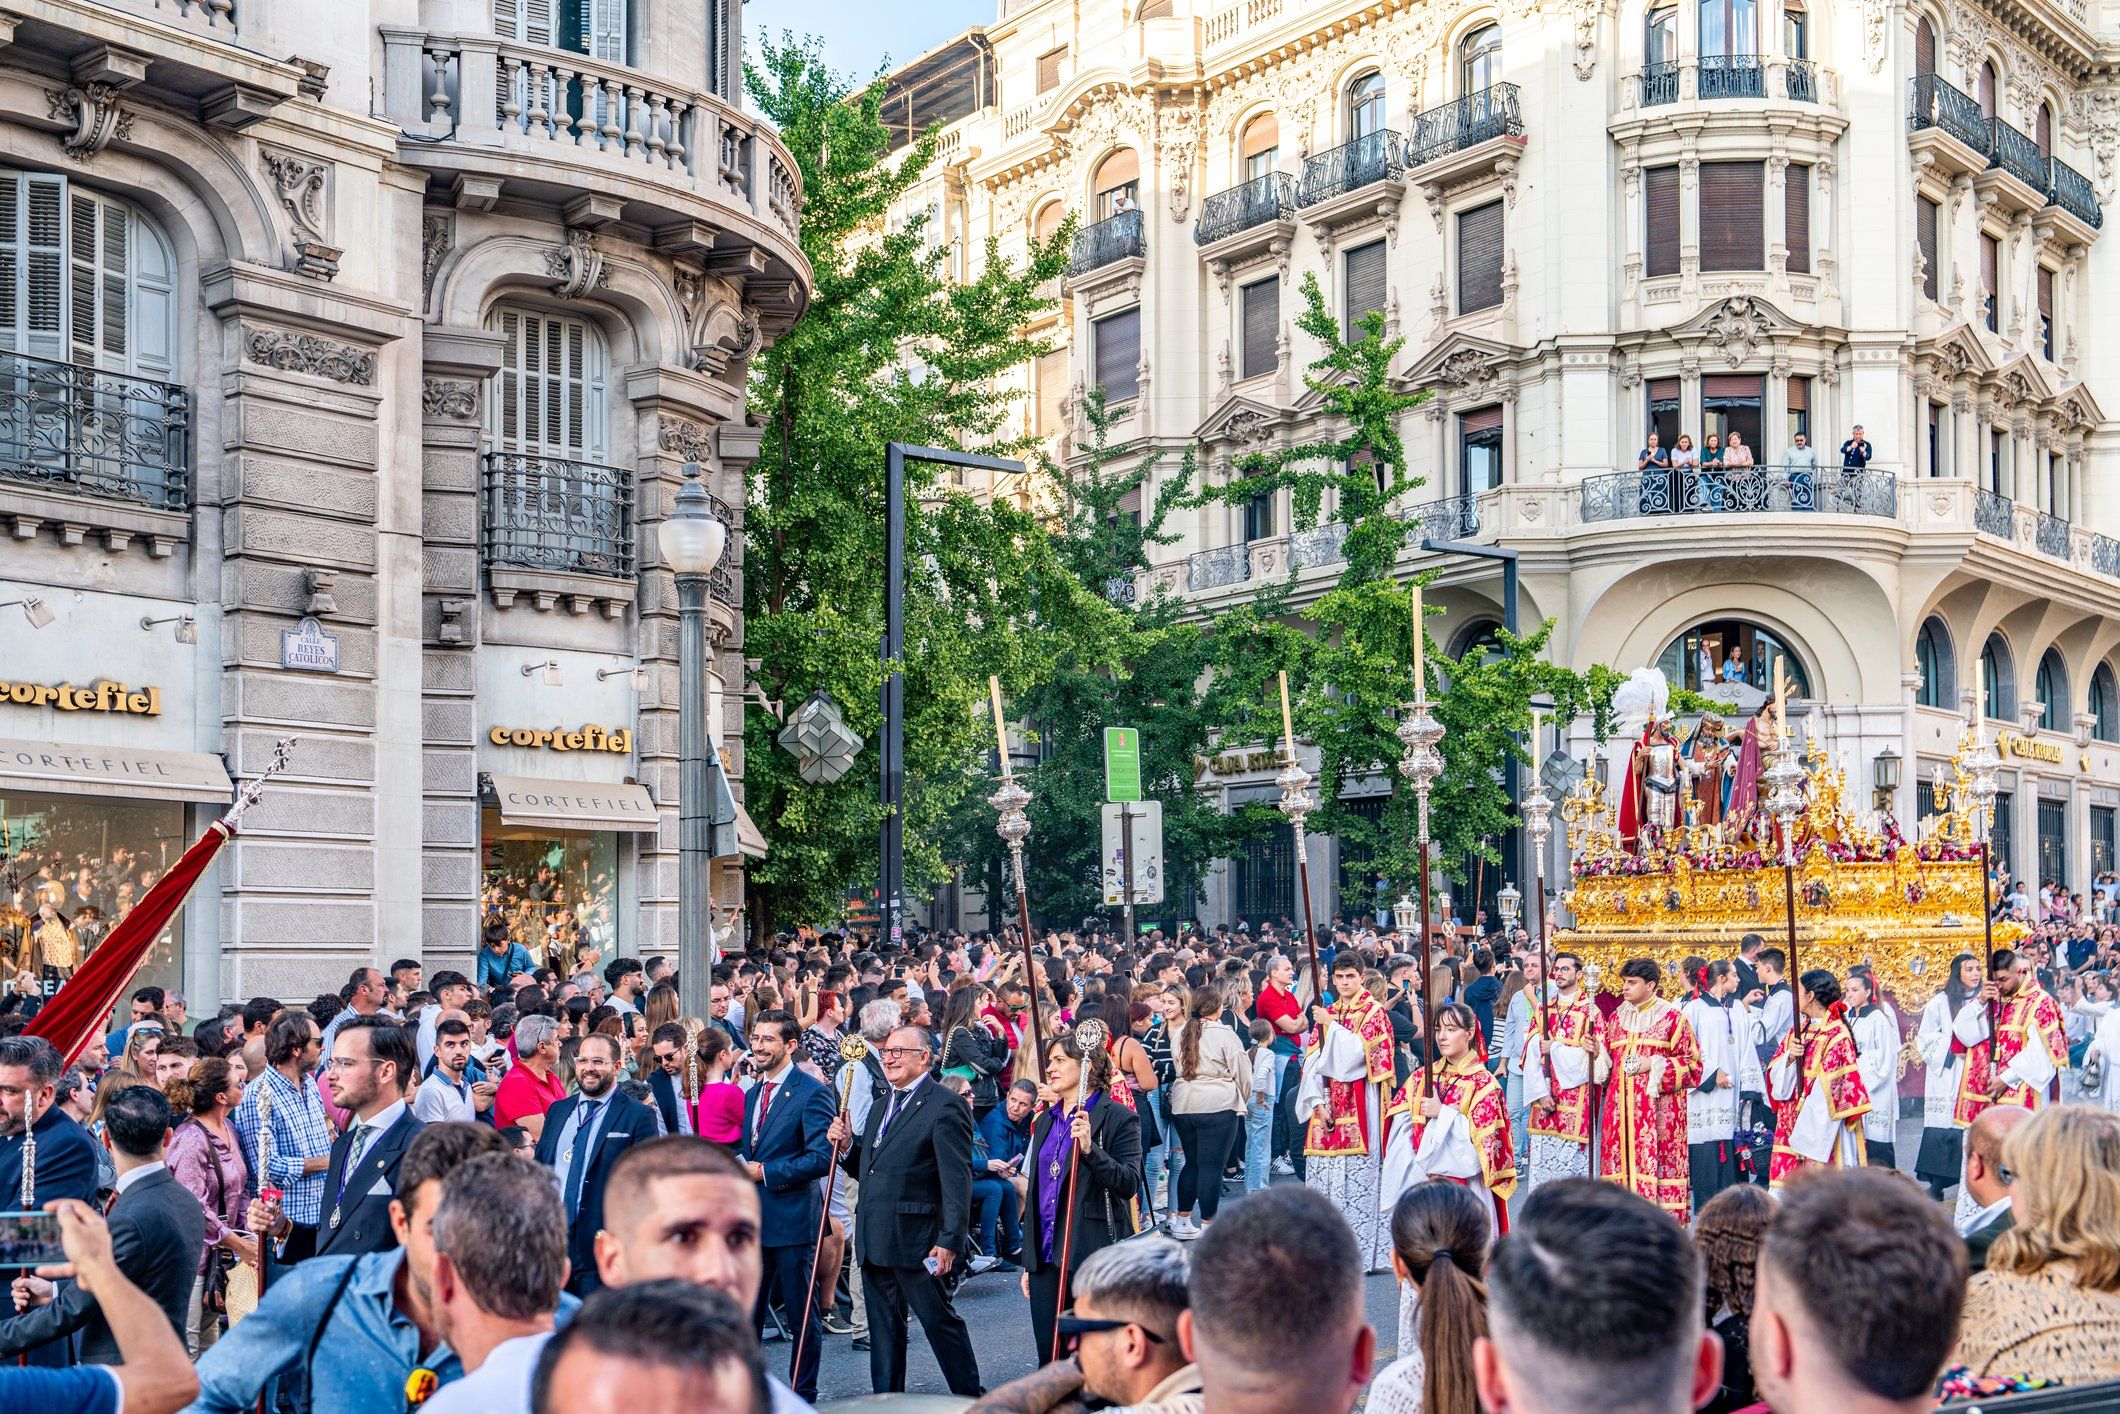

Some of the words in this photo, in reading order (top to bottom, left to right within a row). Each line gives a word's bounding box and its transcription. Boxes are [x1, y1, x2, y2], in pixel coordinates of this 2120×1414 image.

[298, 644, 325, 655] REYES
[300, 636, 320, 644] CALLE
[490, 723, 632, 753] cortefiel
[2011, 737, 2035, 758] CAJA
[2034, 741, 2064, 763] RURAL
[1208, 753, 1246, 774] CAJA
[508, 793, 645, 811] CORTEFIEL
